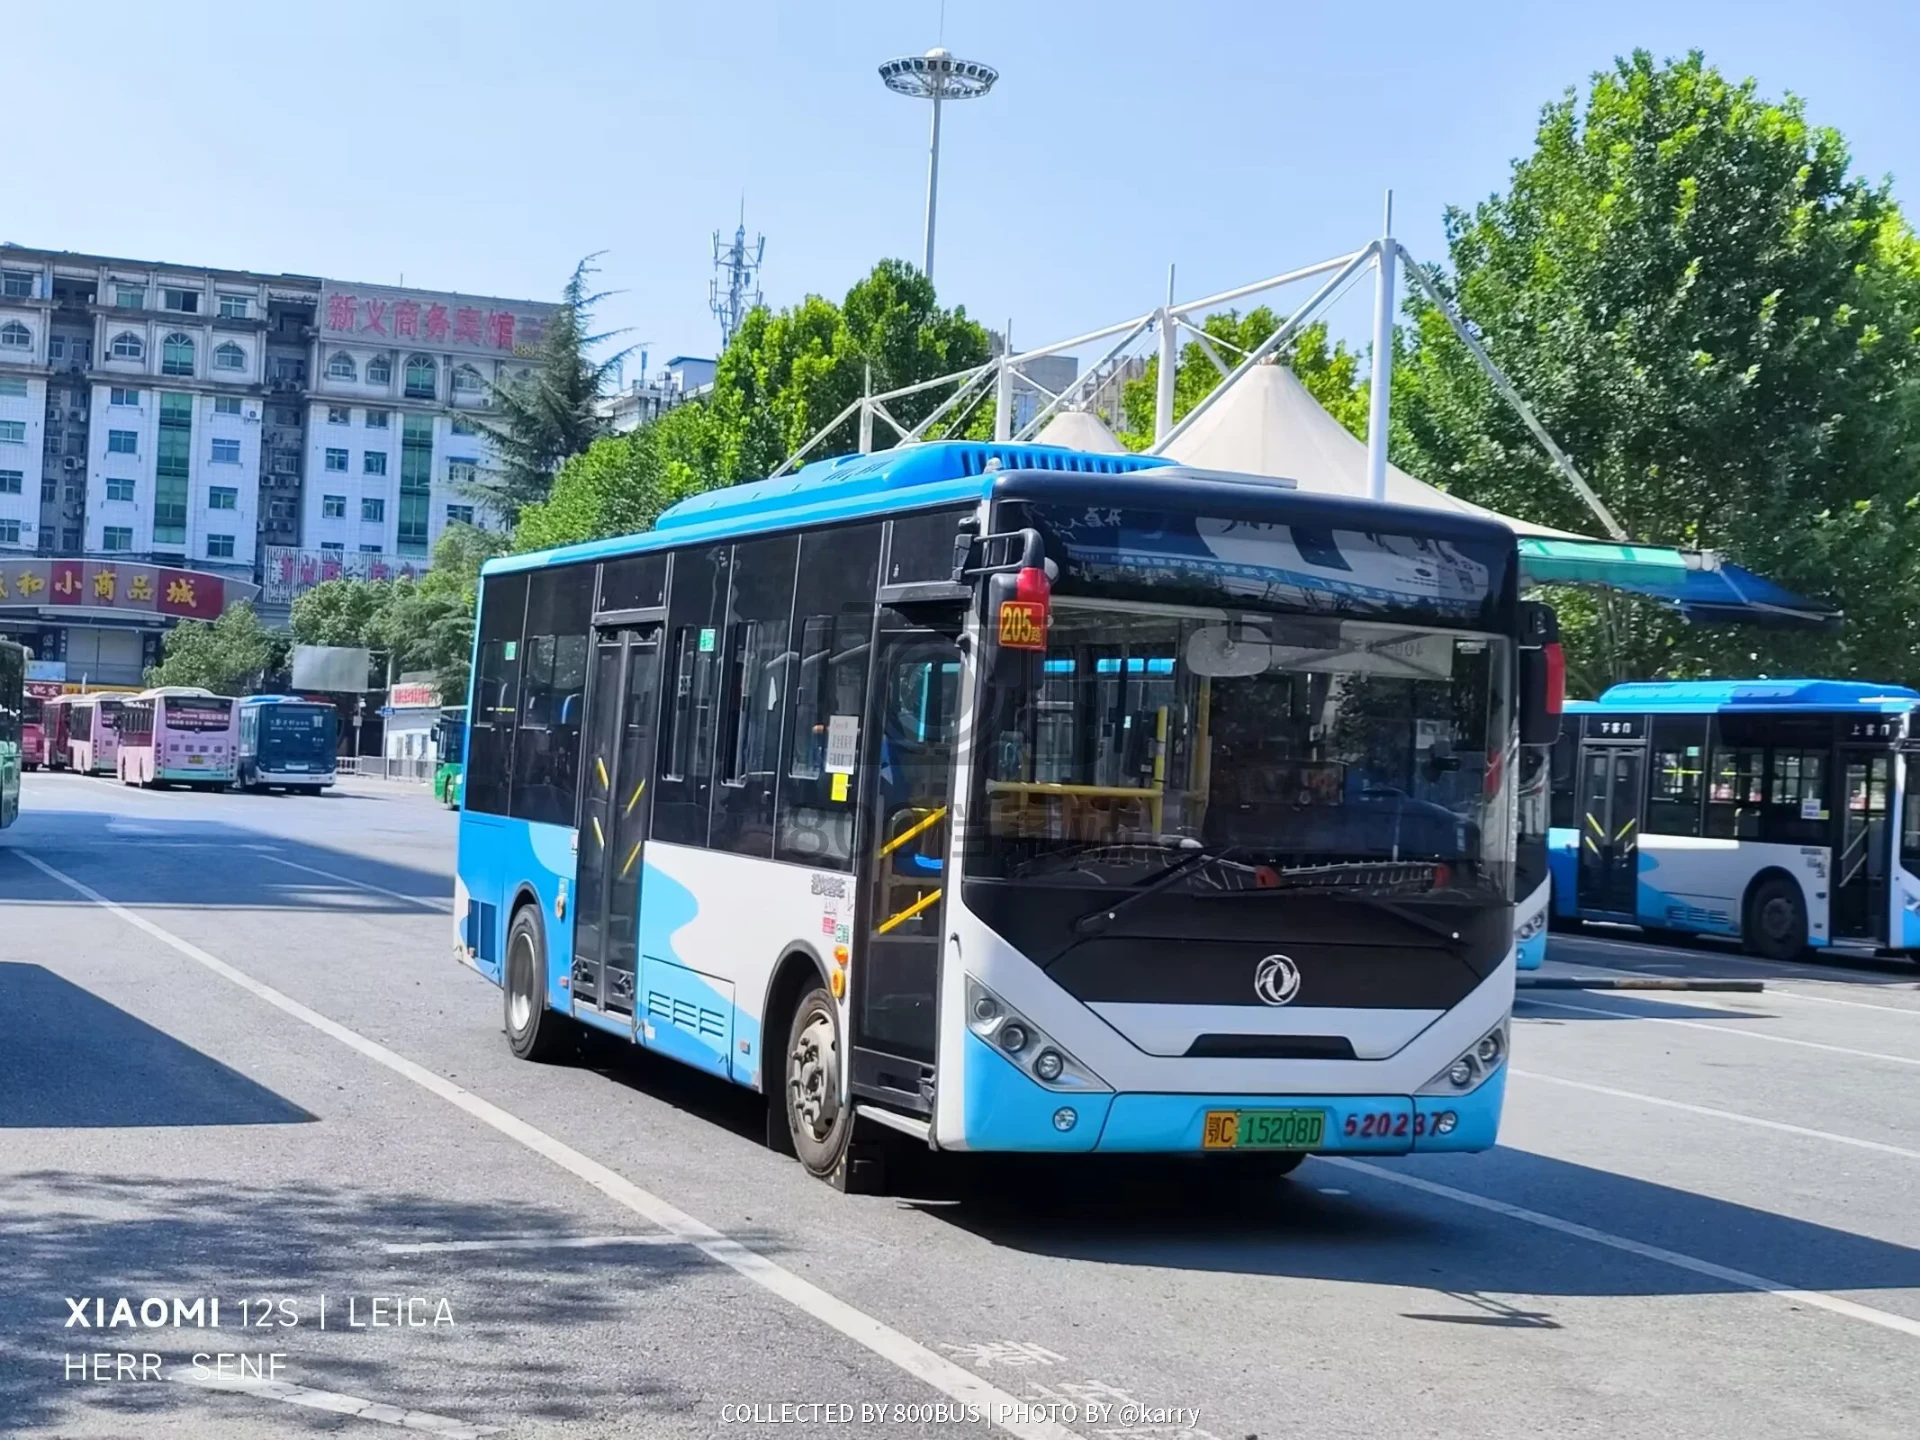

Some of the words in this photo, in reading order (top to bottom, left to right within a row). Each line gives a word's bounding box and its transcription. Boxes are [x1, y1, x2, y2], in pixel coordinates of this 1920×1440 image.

[327, 292, 516, 350] 新义商务宾馆
